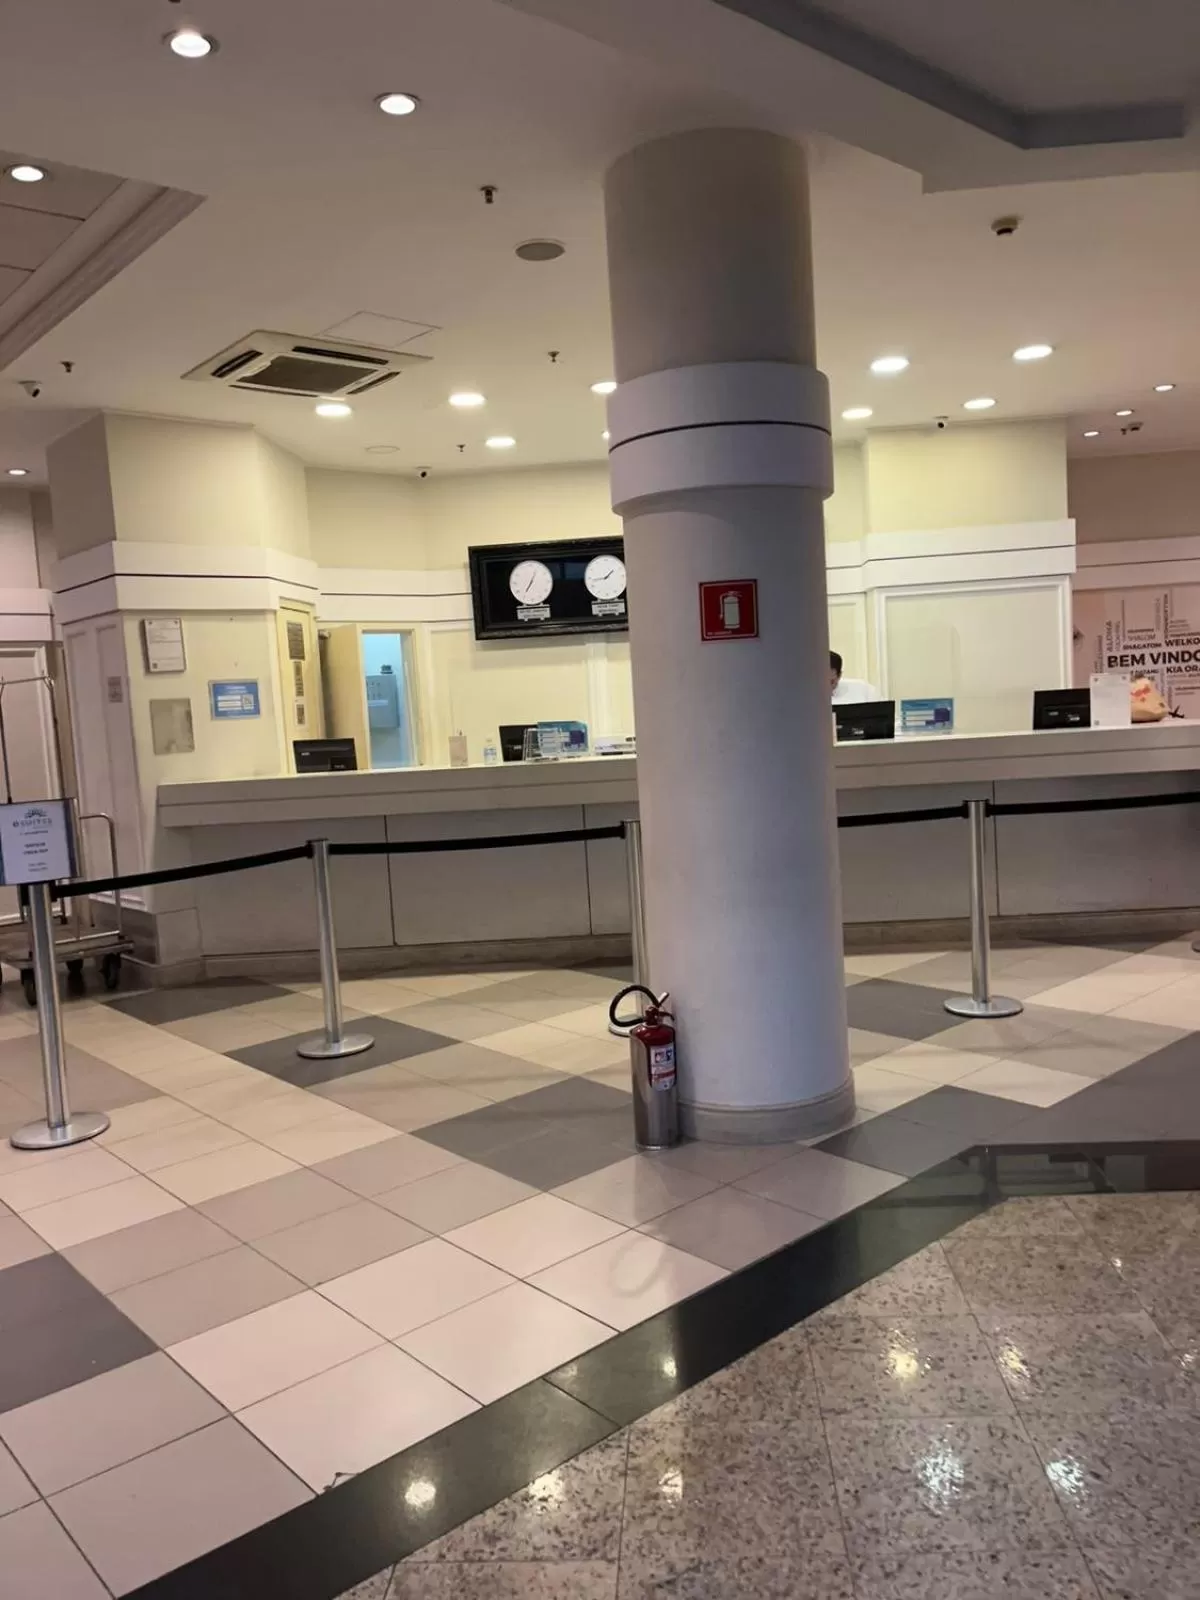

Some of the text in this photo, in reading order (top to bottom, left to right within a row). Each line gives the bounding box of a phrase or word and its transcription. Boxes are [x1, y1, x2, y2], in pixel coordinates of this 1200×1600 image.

[1108, 654, 1145, 668] BEM
[1166, 665, 1200, 674] KIA OR
